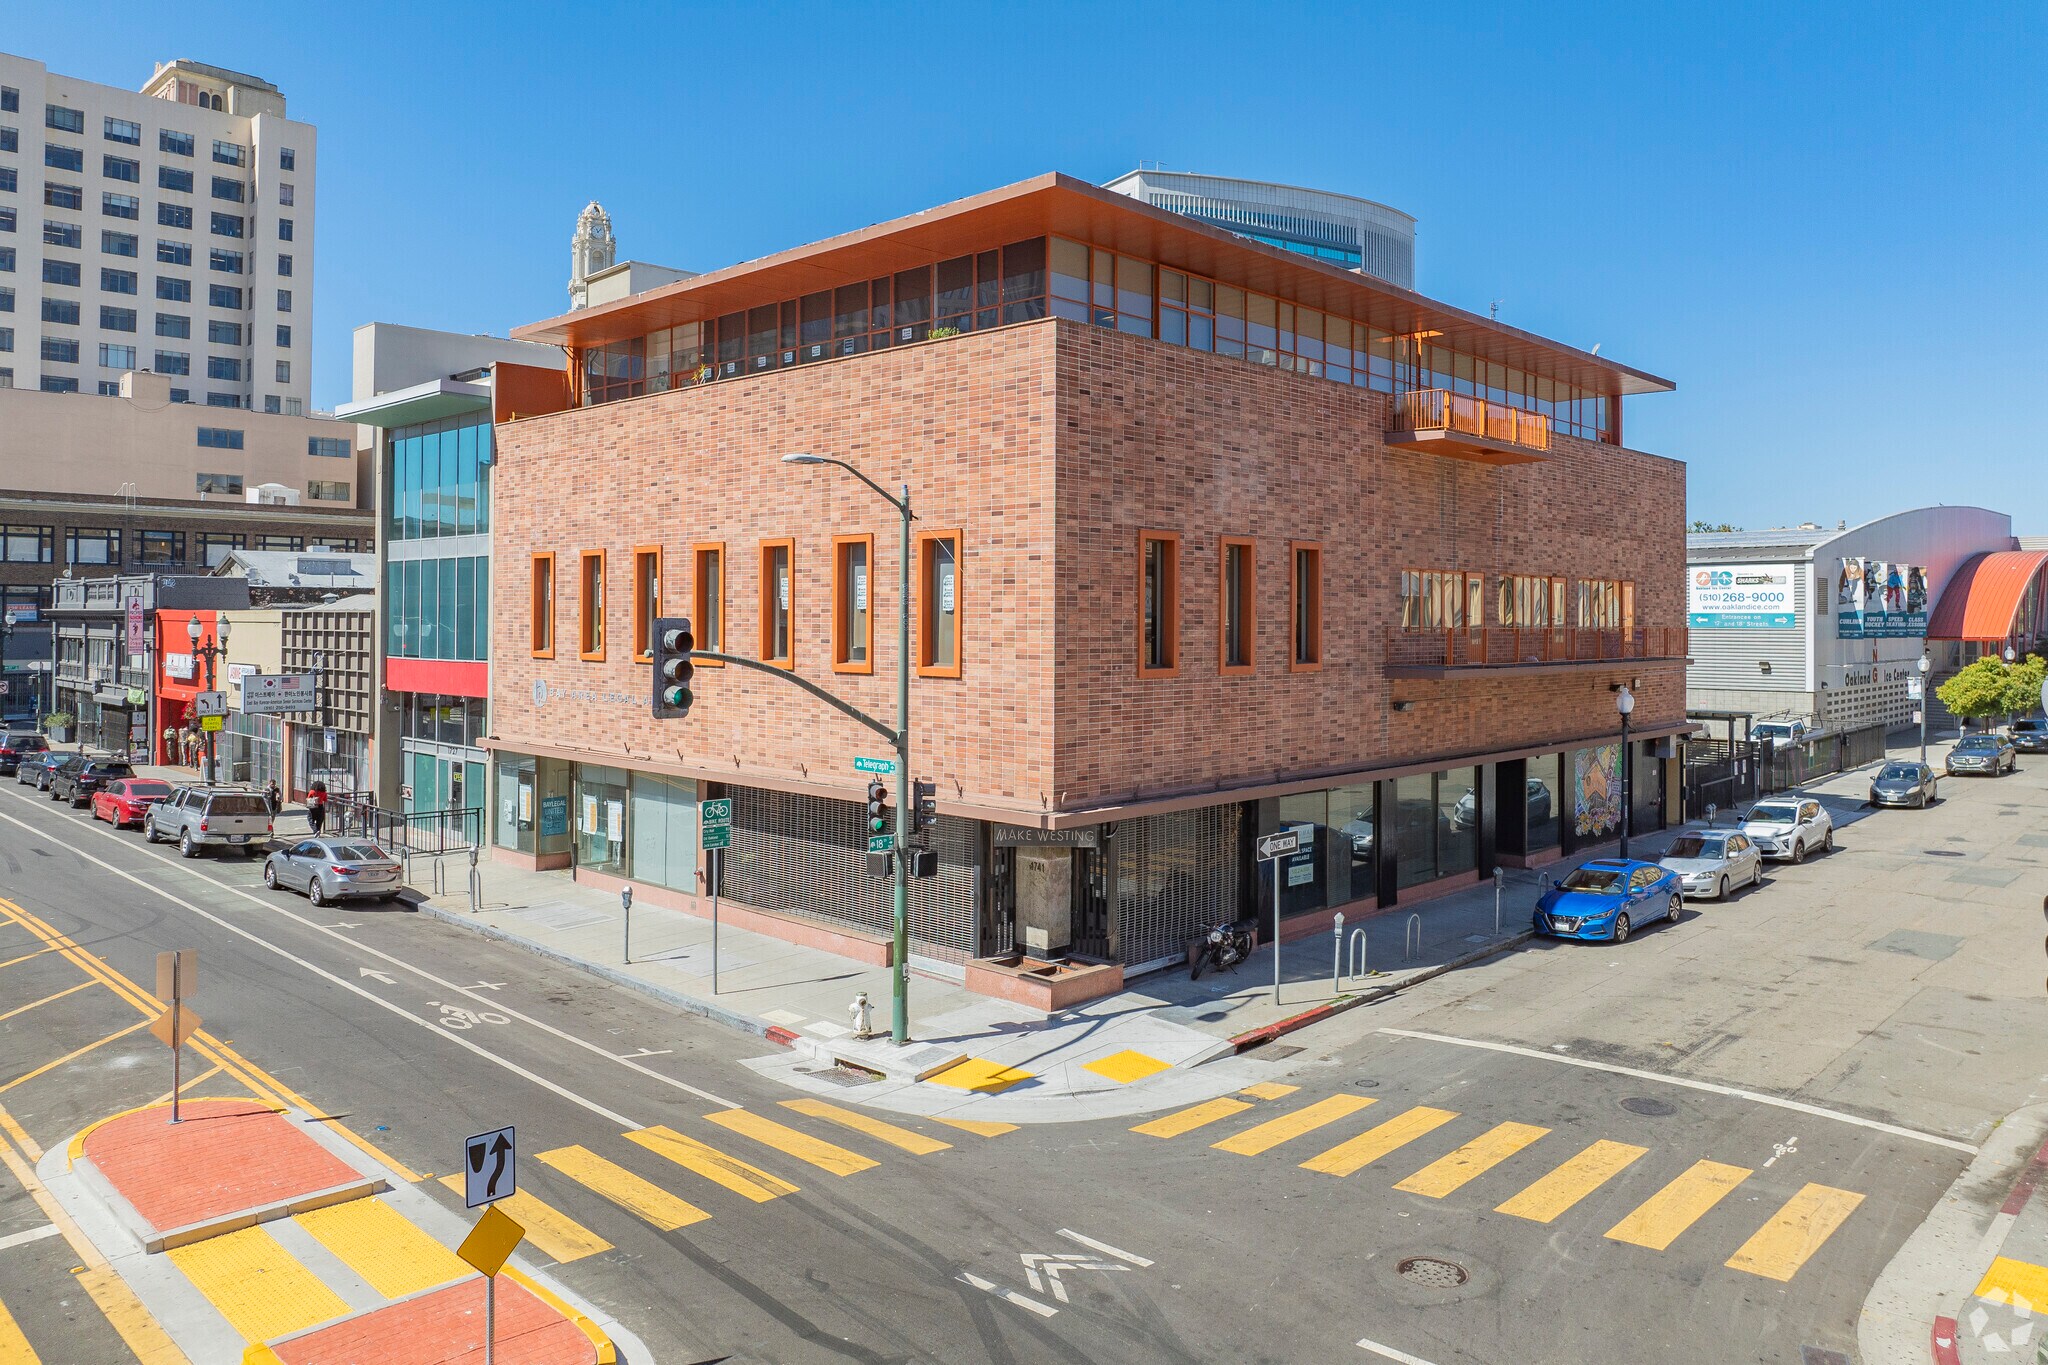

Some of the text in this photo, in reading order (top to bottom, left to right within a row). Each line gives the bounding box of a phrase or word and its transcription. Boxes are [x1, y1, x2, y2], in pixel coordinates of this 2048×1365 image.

[1722, 592, 1785, 602] 268-9000
[1845, 670, 1870, 686] Oakland
[1894, 668, 1910, 681] Center
[549, 688, 567, 698] BAY
[571, 690, 598, 700] AREA
[602, 692, 638, 704] LEGAL
[862, 758, 889, 772] Telegraph
[542, 800, 566, 808] BAYLEGAL
[544, 807, 564, 815] UNITED
[996, 829, 1095, 842] MAKE WESTING
[1270, 838, 1294, 851] ONE WAY
[1292, 854, 1310, 862] AVAILABLE
